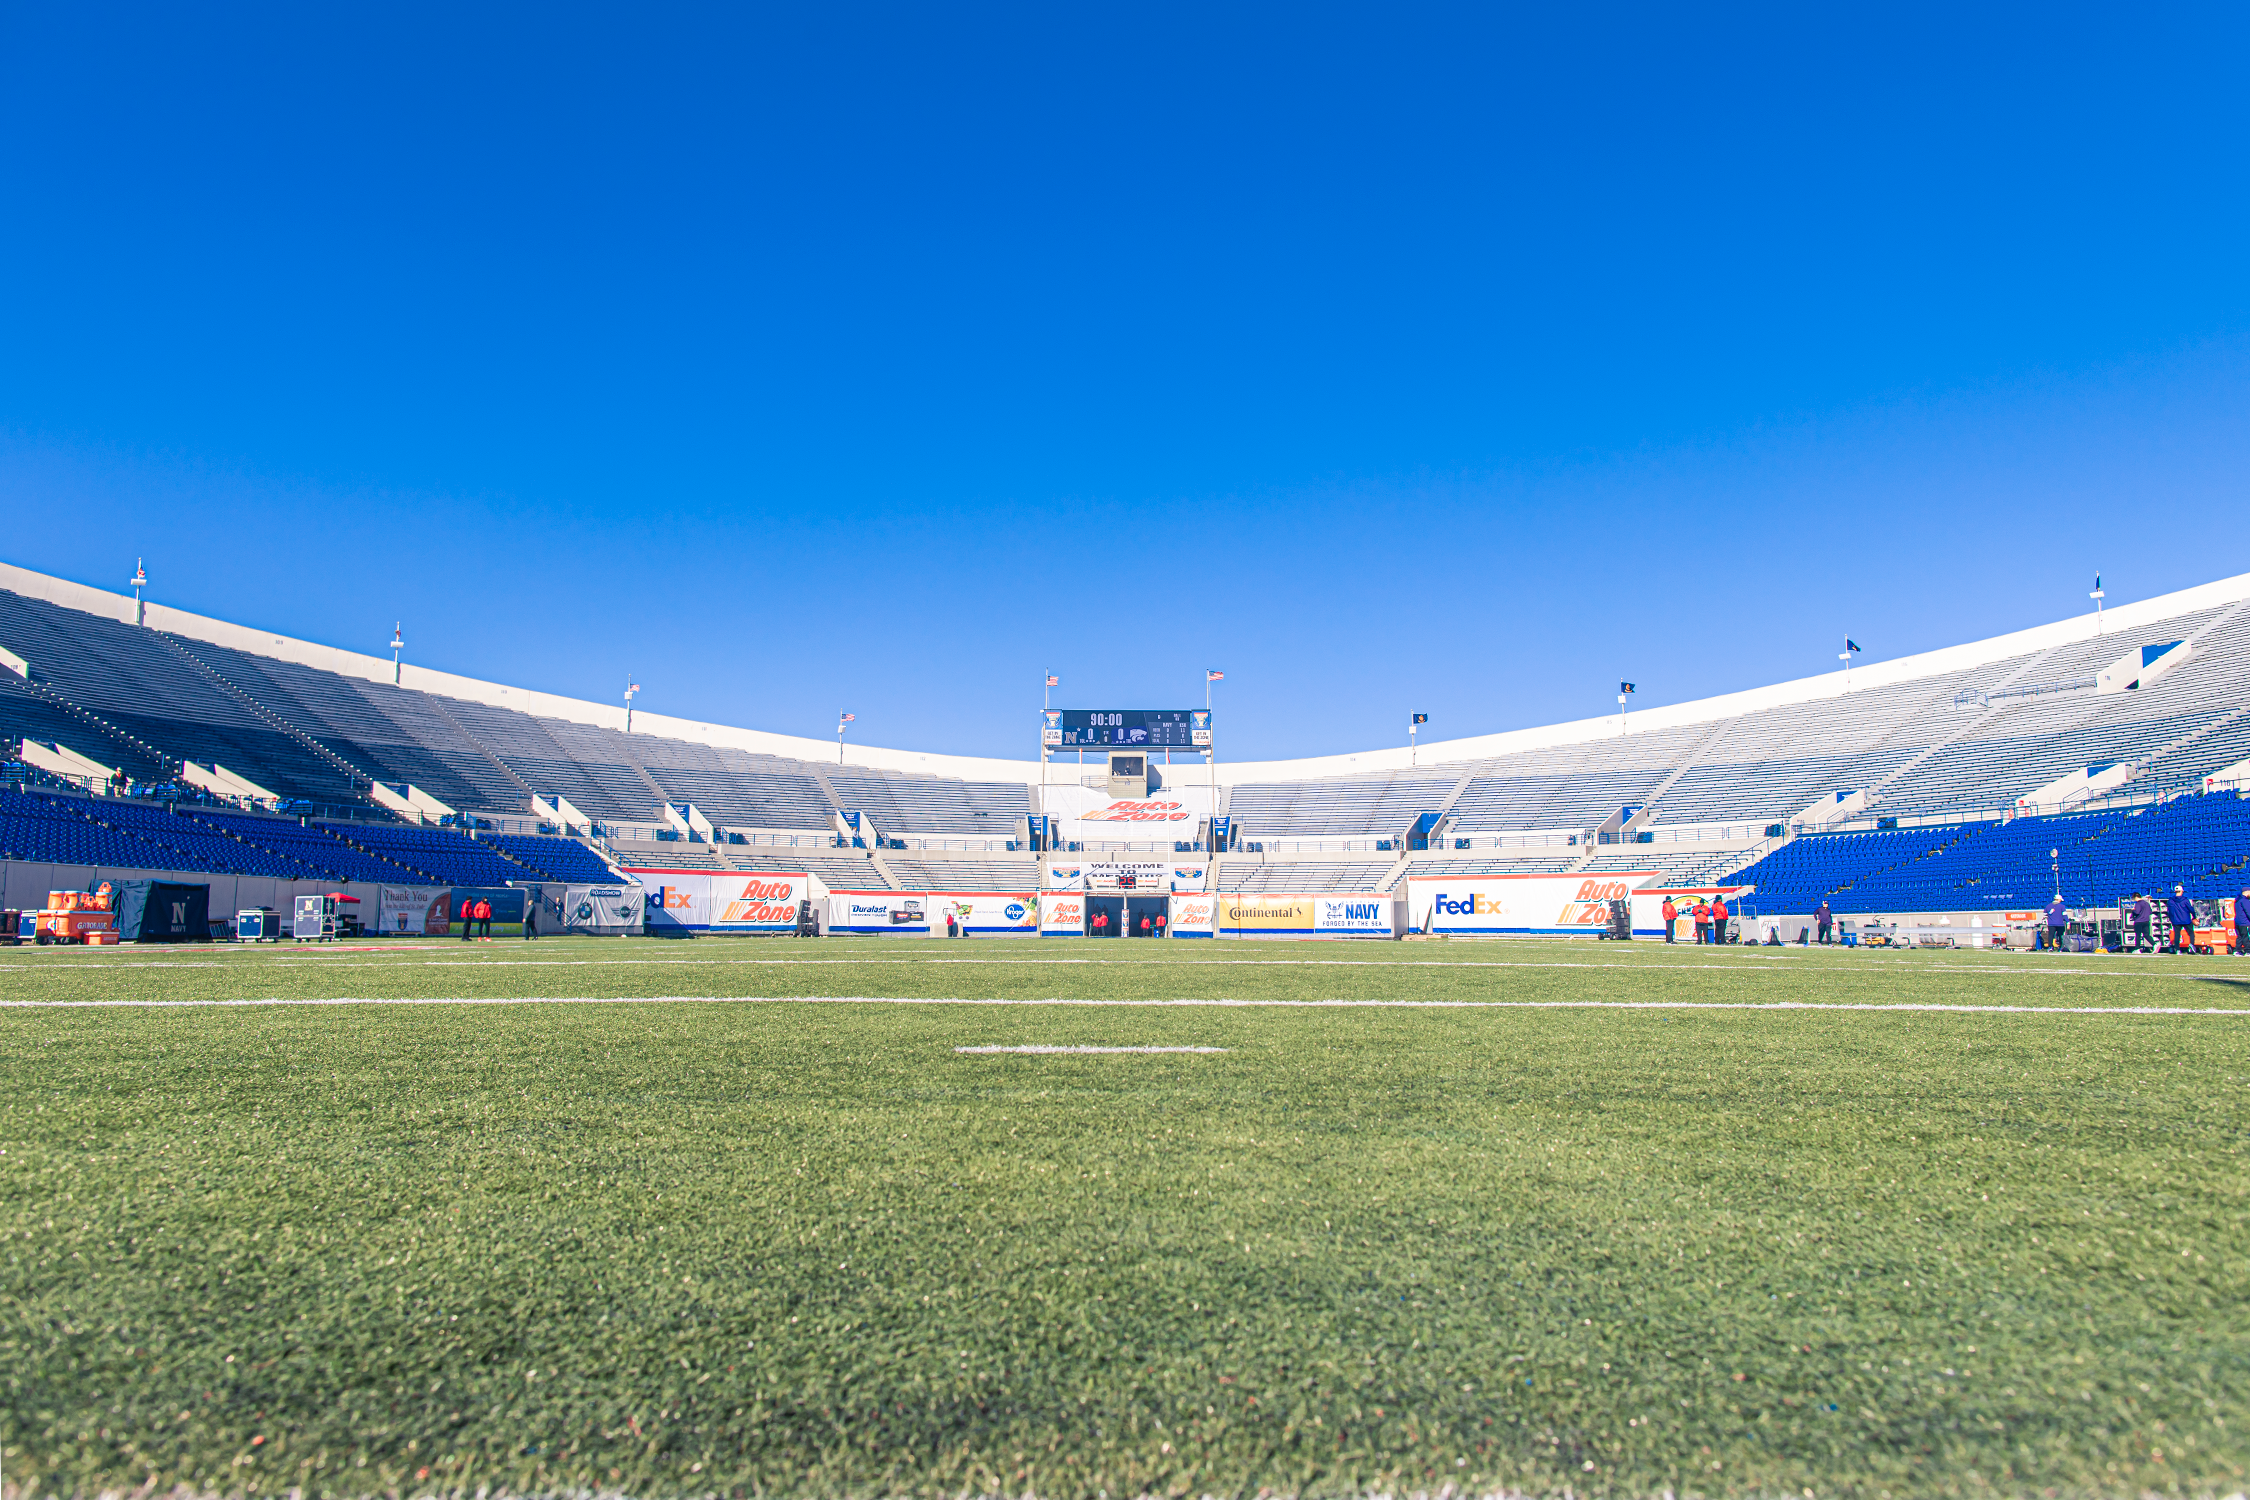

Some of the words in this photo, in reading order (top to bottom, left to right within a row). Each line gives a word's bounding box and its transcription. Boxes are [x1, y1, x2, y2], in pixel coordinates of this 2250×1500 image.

[1090, 713, 1123, 726] 90:00
[1106, 800, 1181, 811] Auto
[1106, 810, 1188, 822] Zone
[385, 889, 409, 902] Thank
[412, 890, 428, 902] You
[740, 879, 792, 900] Auto
[1575, 879, 1628, 901] Auto
[851, 905, 887, 913] Duralast
[1054, 902, 1079, 913] Auto
[1183, 903, 1209, 913] Auto
[1435, 893, 1503, 915] FedEx
[172, 902, 186, 924] N
[741, 901, 797, 921] Zone
[1229, 906, 1293, 921] Continental
[1345, 904, 1380, 919] NAVY
[1054, 913, 1082, 923] Zone
[1183, 913, 1211, 924] Zone
[171, 925, 186, 933] NAVY
